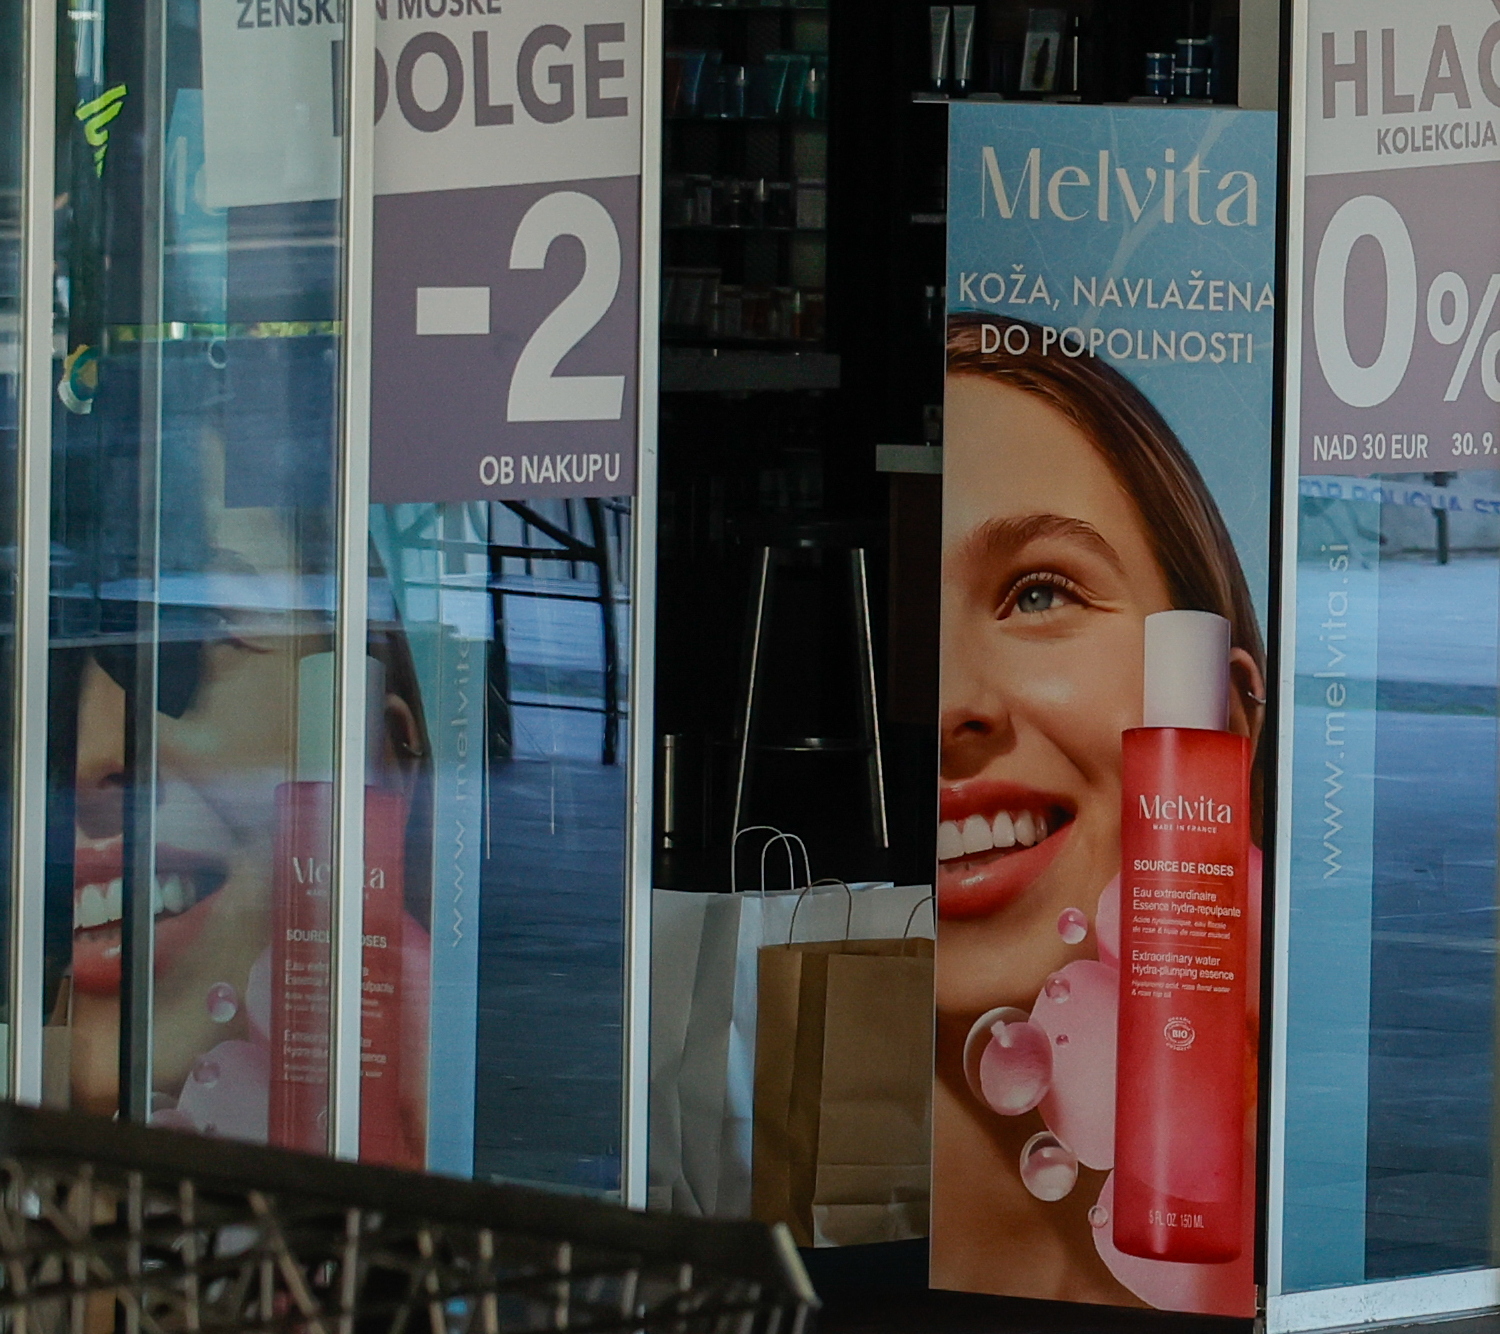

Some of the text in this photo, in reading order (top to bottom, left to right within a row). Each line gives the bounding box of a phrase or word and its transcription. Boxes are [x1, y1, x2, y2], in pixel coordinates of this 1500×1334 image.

[330, 22, 629, 137] DOLGE
[1377, 120, 1497, 155] KOLEKCIJA
[976, 146, 1258, 227] Melvita
[959, 264, 1275, 312] KOŽA, NAVLAŽENA
[416, 190, 626, 423] -2
[981, 324, 1254, 364] DO POPOLNOSTI
[1312, 435, 1358, 462] NAD
[1363, 434, 1387, 460] 30
[1391, 433, 1429, 458] EUR
[1452, 432, 1478, 455] 30.
[479, 453, 621, 485] OB NAKUPU
[1314, 542, 1350, 880] www.melvita.si
[1139, 794, 1232, 824] Melvita
[1133, 859, 1234, 877] SOURCE DE ROSES
[1133, 887, 1217, 902] Eau extraordinaire
[1133, 899, 1169, 911] Essence
[1132, 950, 1221, 966] Extraordinary water
[1132, 963, 1235, 980] Hydra-plumping essence
[1172, 1029, 1188, 1039] BIO
